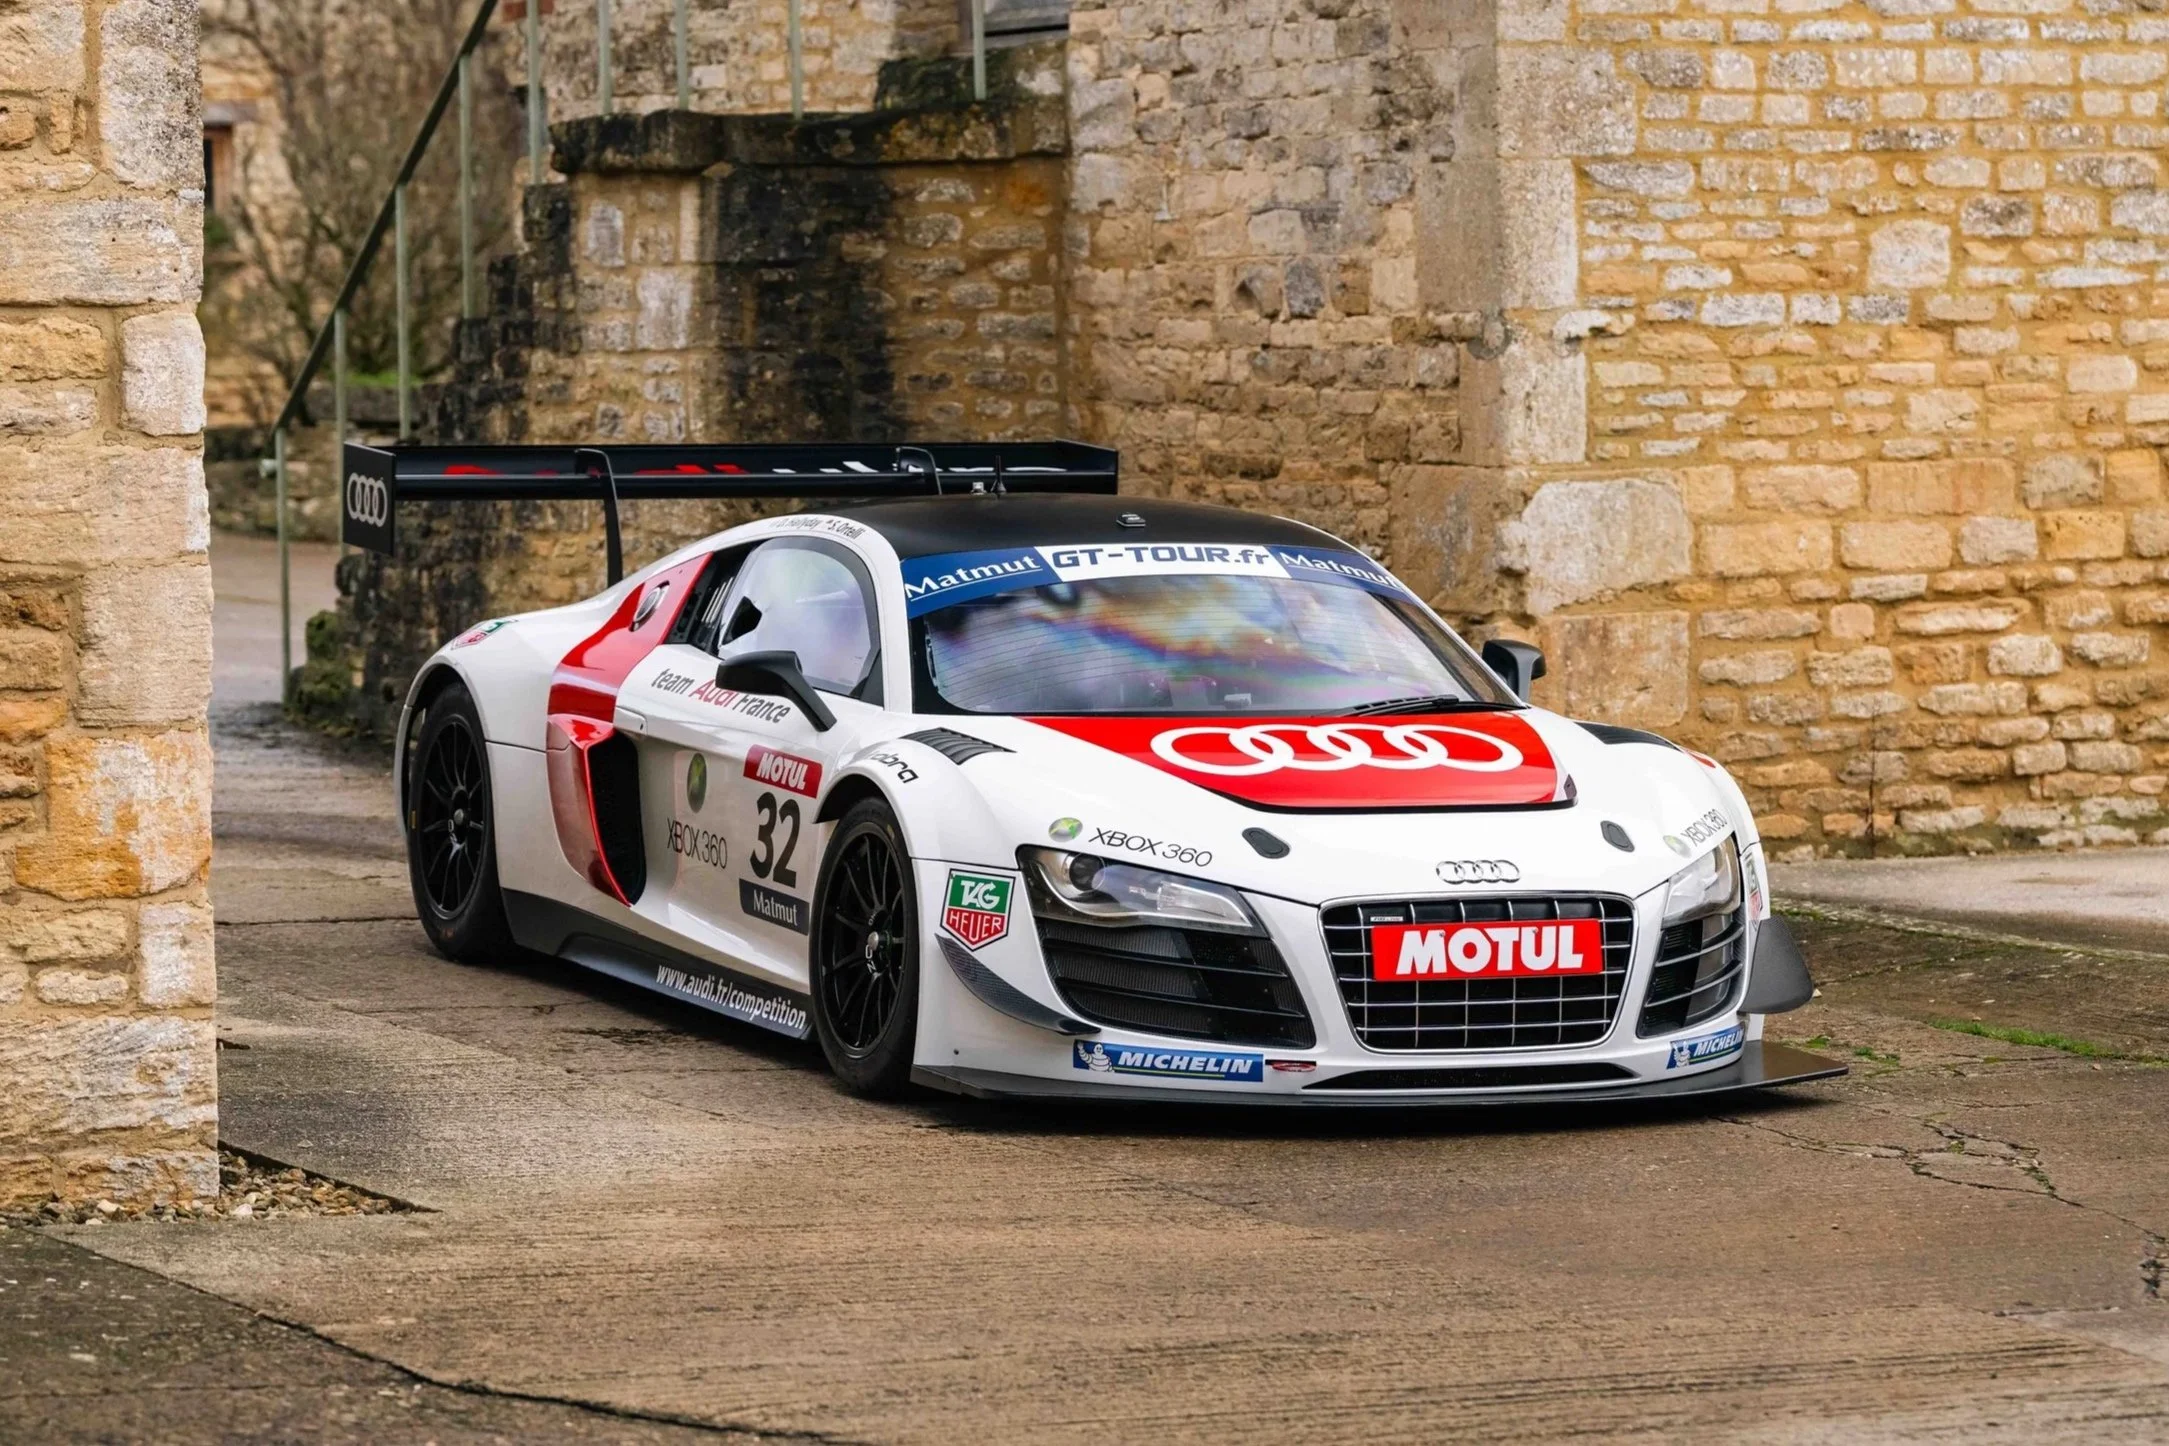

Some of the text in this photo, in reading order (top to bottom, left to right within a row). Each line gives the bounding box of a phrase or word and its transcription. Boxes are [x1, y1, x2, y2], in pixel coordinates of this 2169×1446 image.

[904, 554, 1042, 599] Matmut
[1052, 545, 1271, 570] GT-TOUR.fr
[1280, 551, 1402, 589] Matmut
[651, 668, 695, 695] team
[732, 693, 791, 724] France
[756, 751, 809, 791] MOTUL
[667, 817, 728, 869] XBOX 360
[750, 791, 801, 889] 32
[1088, 827, 1213, 868] XBOX 360
[1680, 808, 1728, 848] XBOX 360
[752, 889, 798, 926] Matmut
[961, 879, 1000, 910] TAG
[949, 910, 1002, 942] HEUER
[1395, 925, 1584, 975] MOTUL
[656, 965, 807, 1030] www.audi.fr/competition
[1117, 1051, 1253, 1074] MICHELIN
